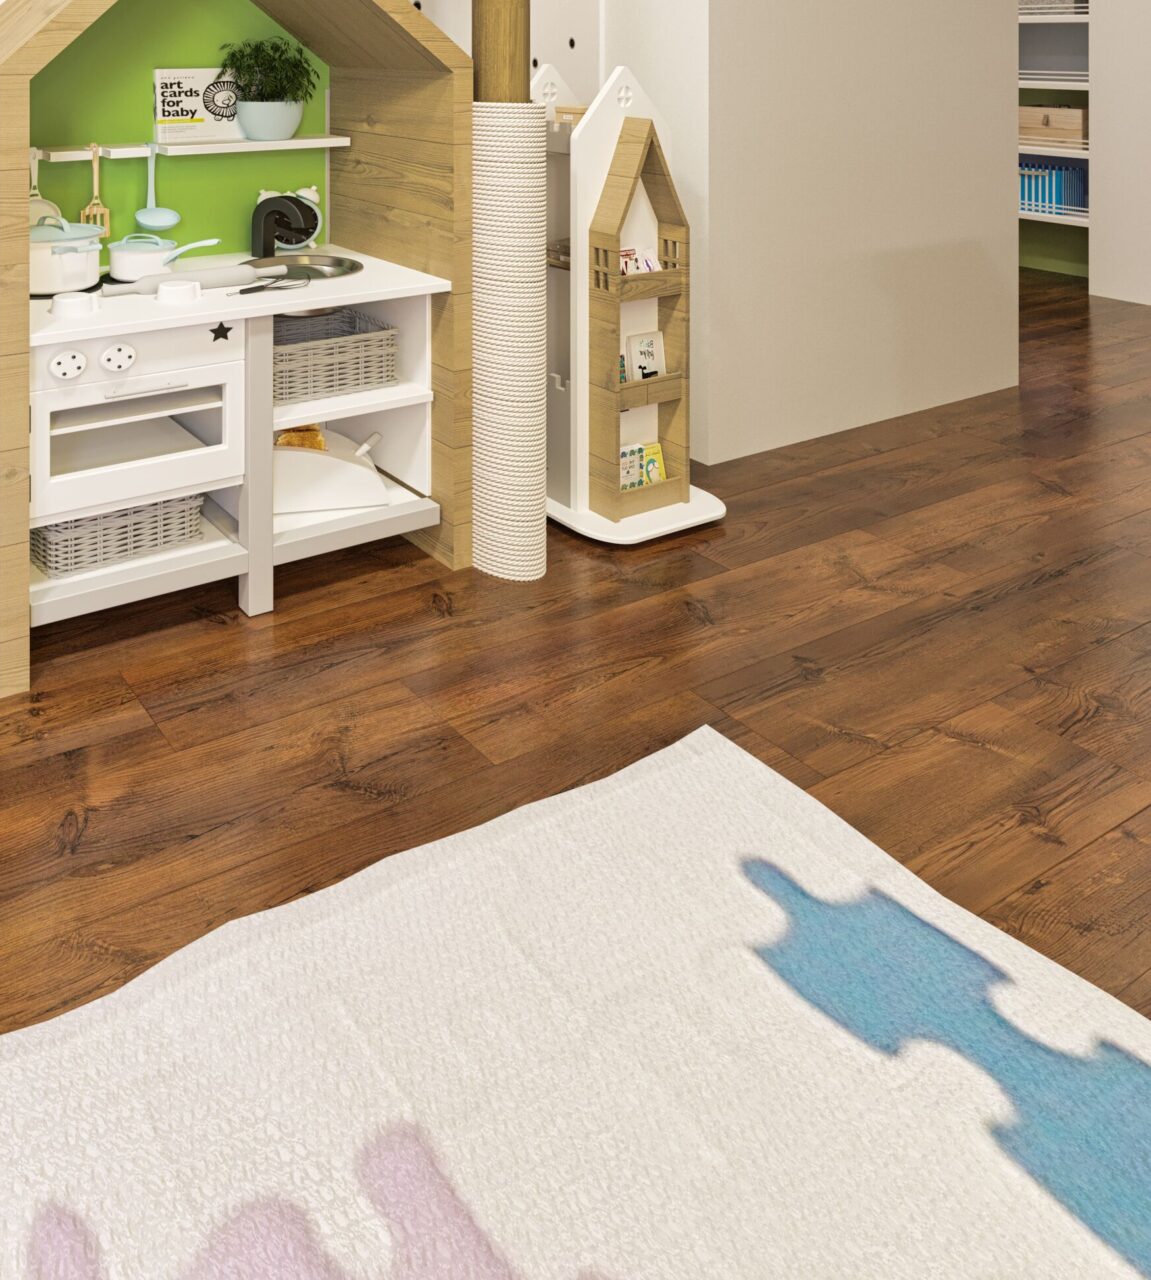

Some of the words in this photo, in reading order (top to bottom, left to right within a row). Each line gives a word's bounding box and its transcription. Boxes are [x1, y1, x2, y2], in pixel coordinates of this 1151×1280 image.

[160, 81, 183, 90] art
[160, 88, 200, 98] cards
[161, 98, 183, 107] for
[162, 108, 197, 119] baby
